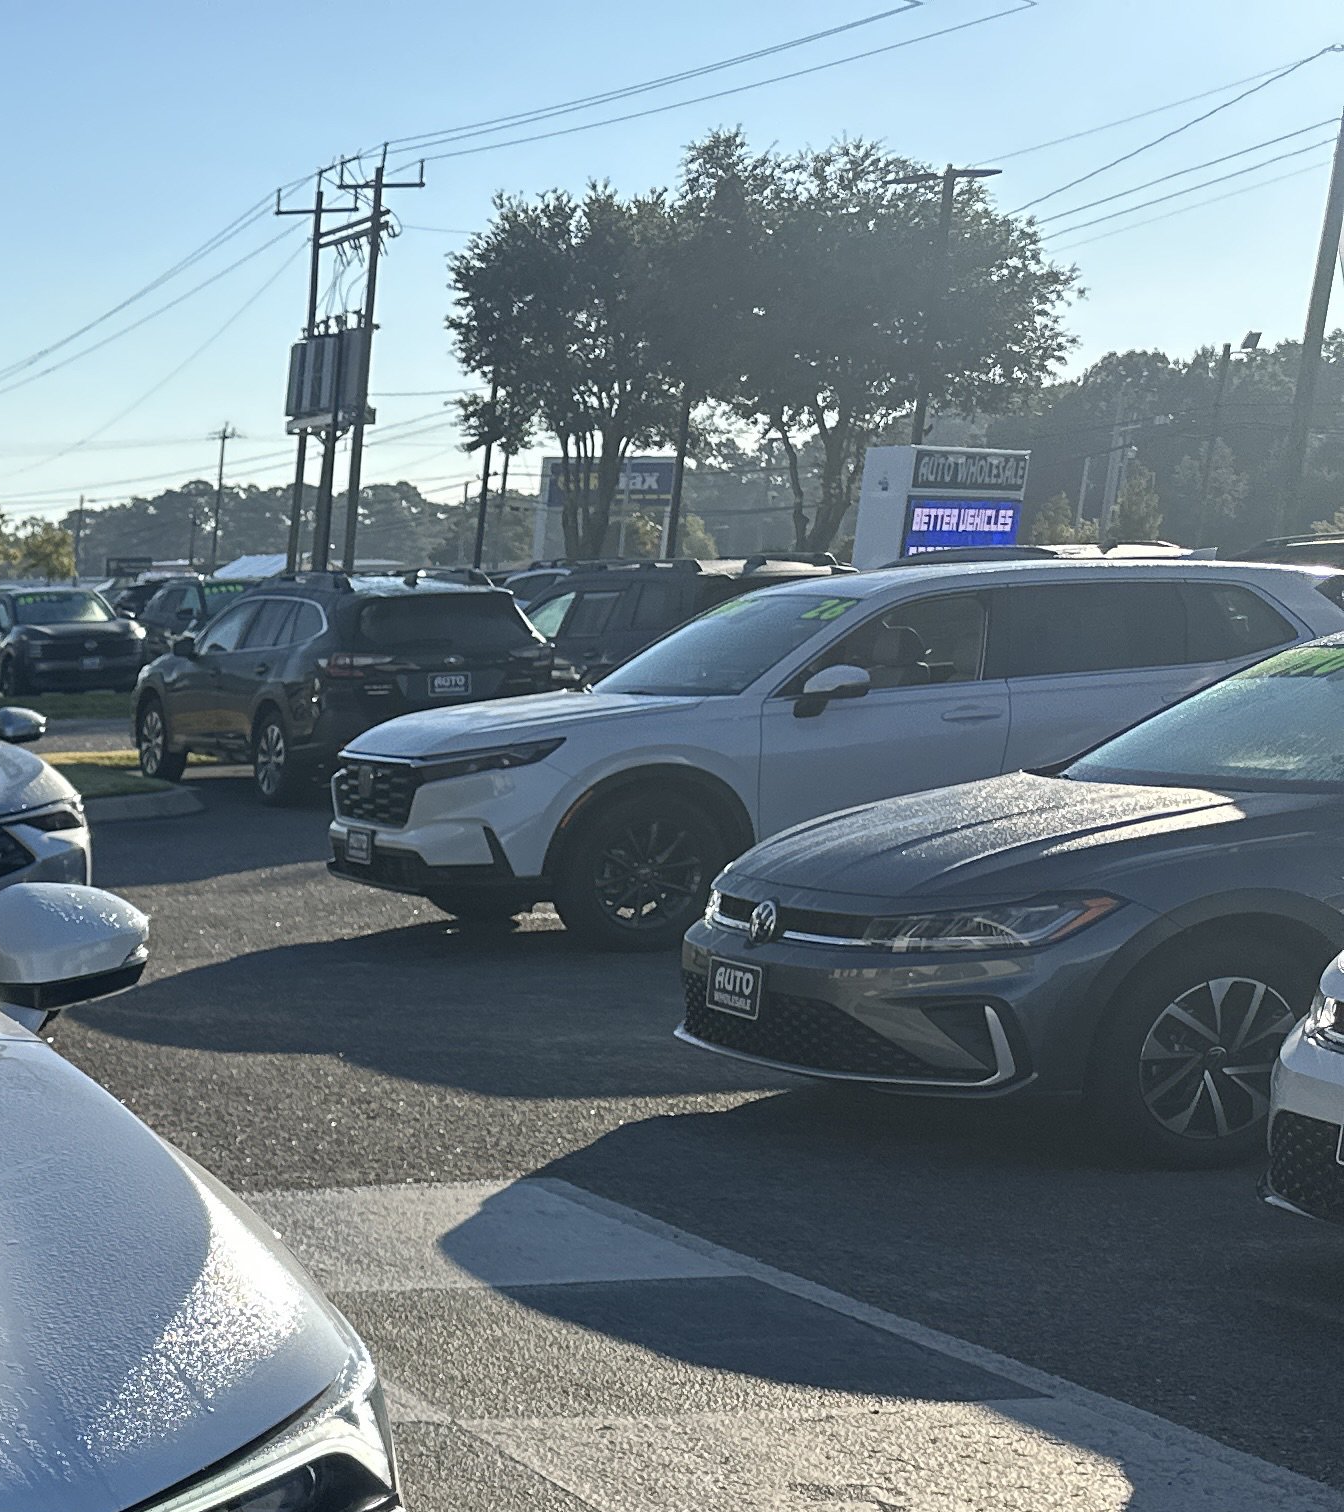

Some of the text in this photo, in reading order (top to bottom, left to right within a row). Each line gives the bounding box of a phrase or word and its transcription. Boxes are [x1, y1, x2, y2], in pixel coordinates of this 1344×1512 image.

[918, 456, 1025, 485] AUTO WHOLESALE
[912, 508, 1013, 532] BETTER VEHICLES
[715, 966, 754, 995] AUTO
